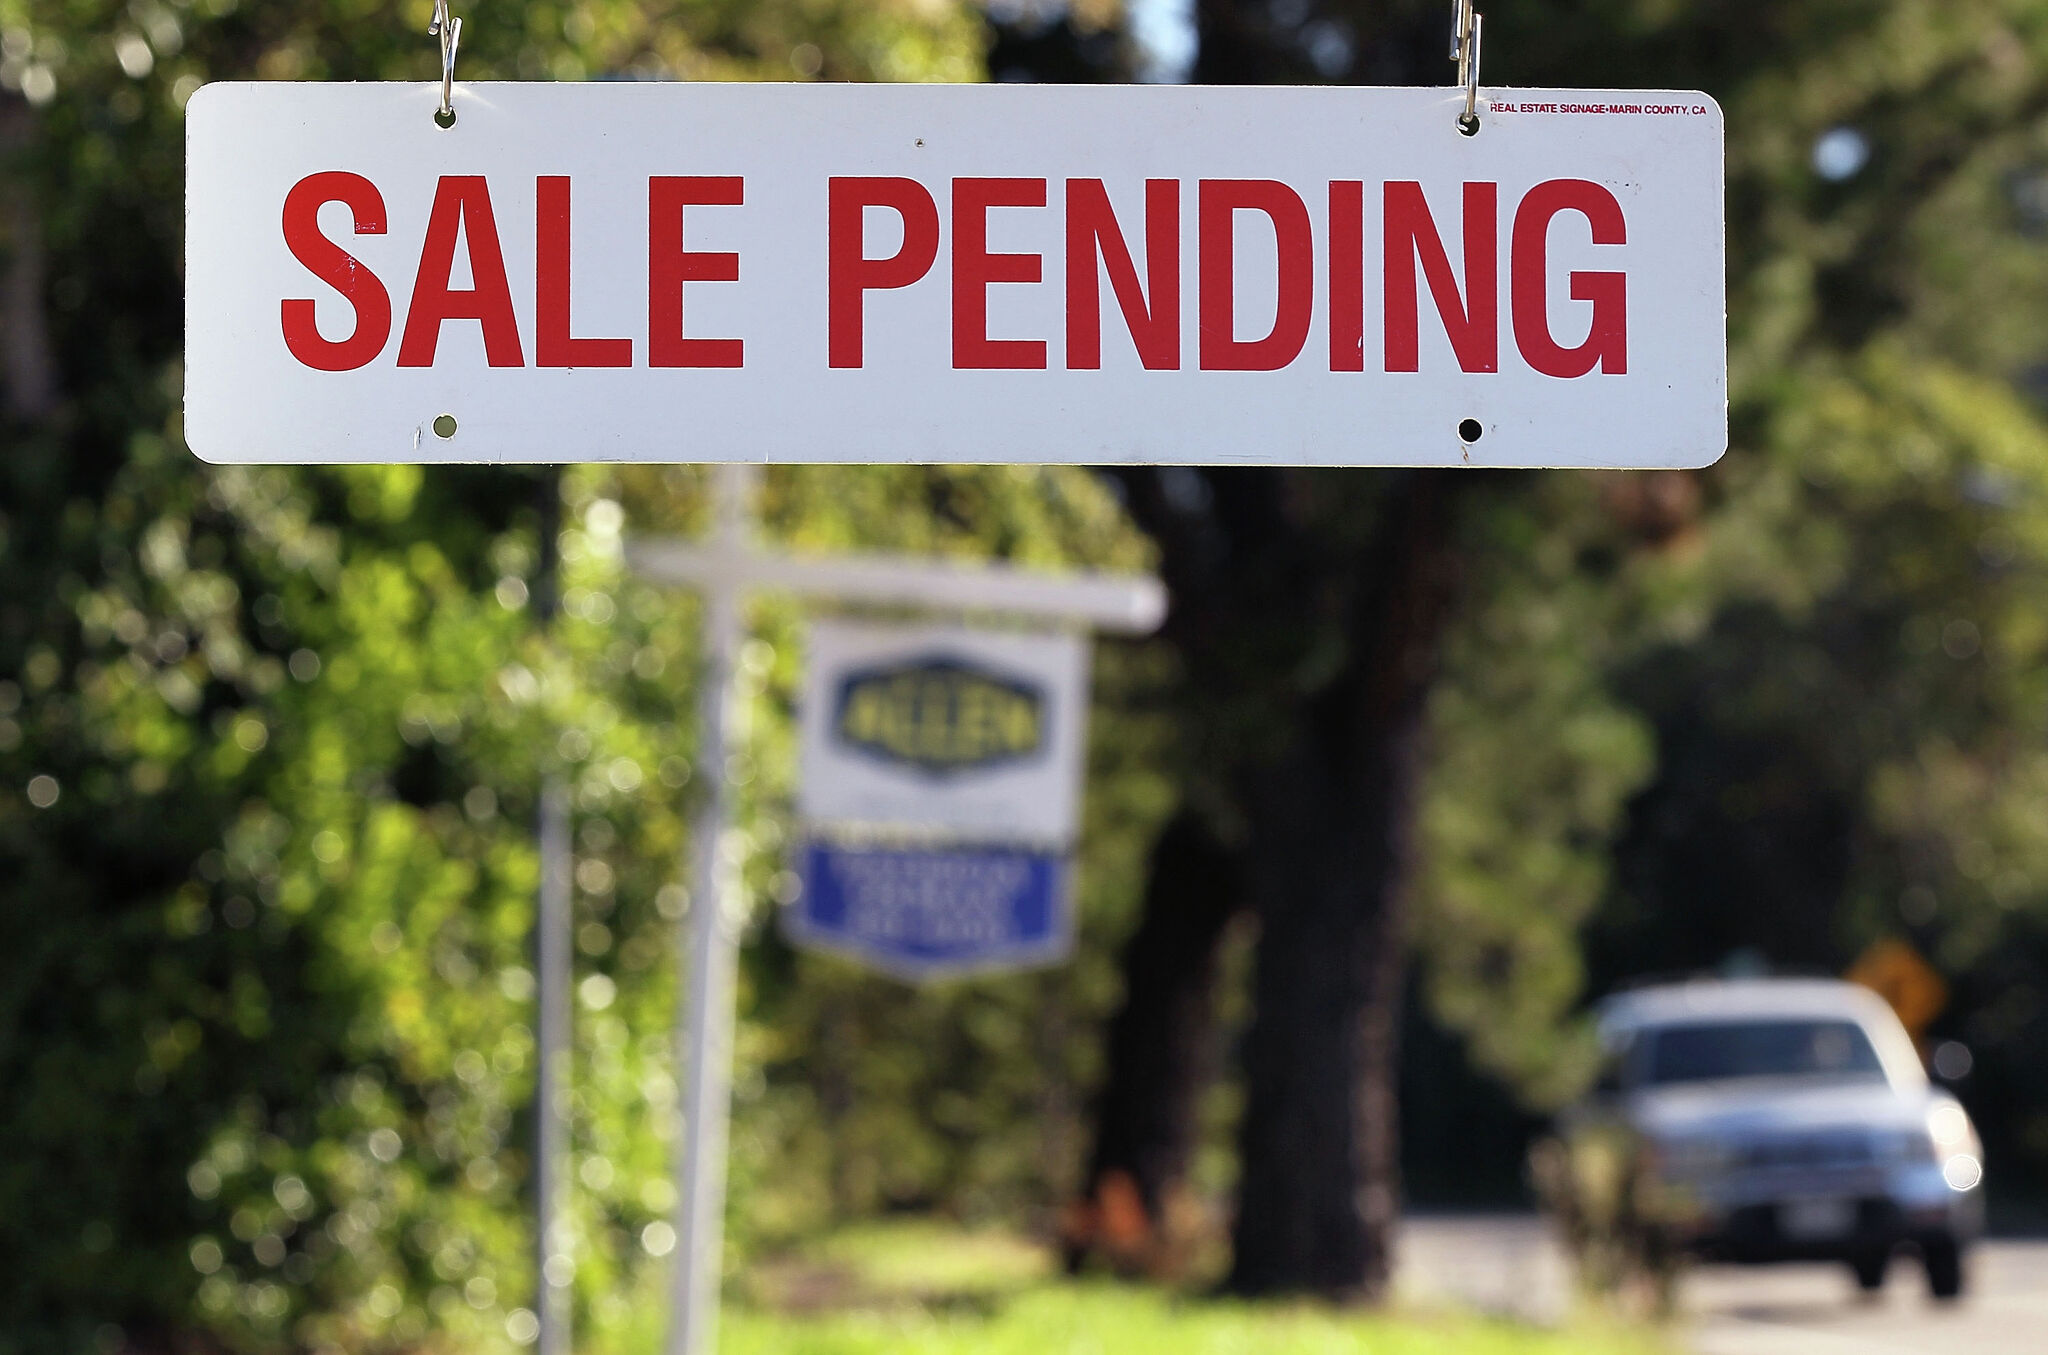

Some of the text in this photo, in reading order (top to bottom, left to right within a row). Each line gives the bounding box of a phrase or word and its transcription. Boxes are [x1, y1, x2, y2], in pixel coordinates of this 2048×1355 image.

[1490, 103, 1517, 114] REAL
[1520, 103, 1557, 114] ESTATE
[1644, 104, 1689, 116] COUNTY,
[1691, 105, 1707, 116] CA
[282, 171, 1628, 379] SALE PENDING
